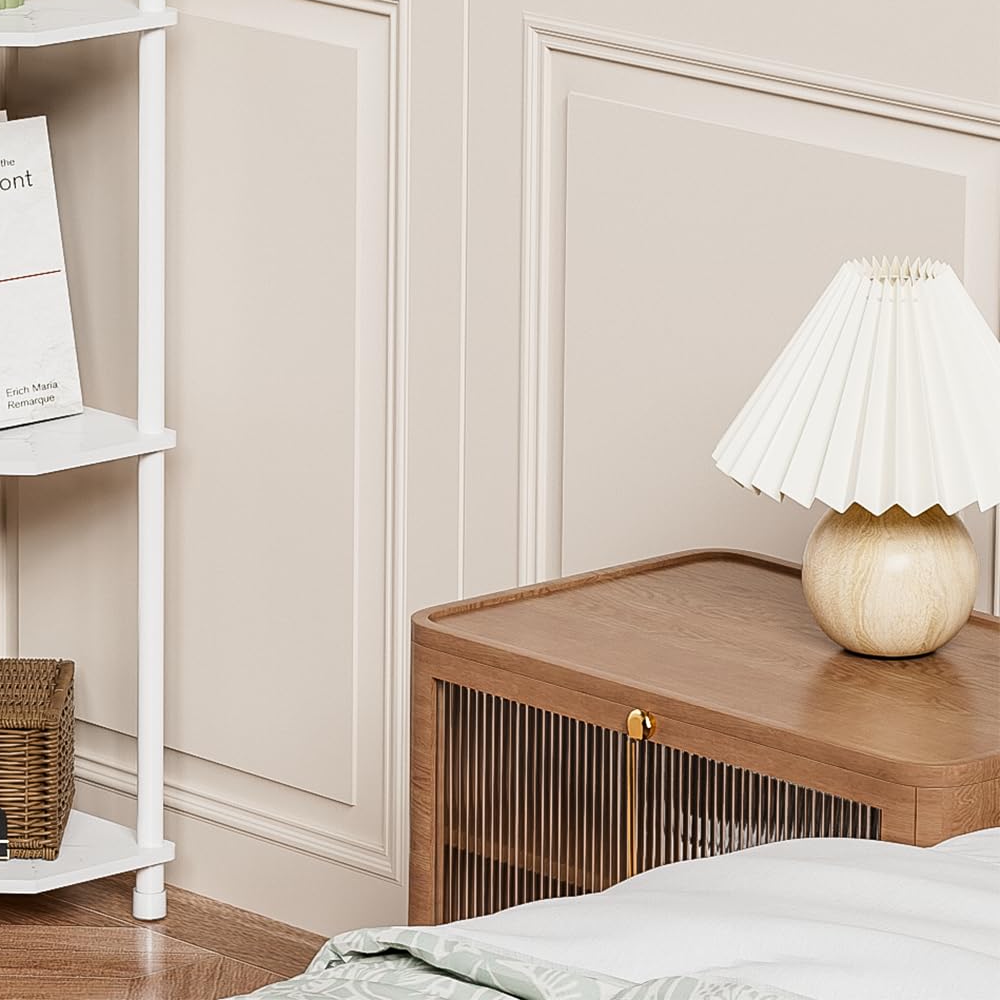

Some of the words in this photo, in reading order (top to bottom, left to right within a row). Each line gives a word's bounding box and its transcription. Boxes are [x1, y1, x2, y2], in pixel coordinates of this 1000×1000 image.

[0, 158, 15, 168] the
[5, 386, 30, 398] Erich
[32, 381, 58, 392] Maria
[7, 394, 55, 409] Remarque
